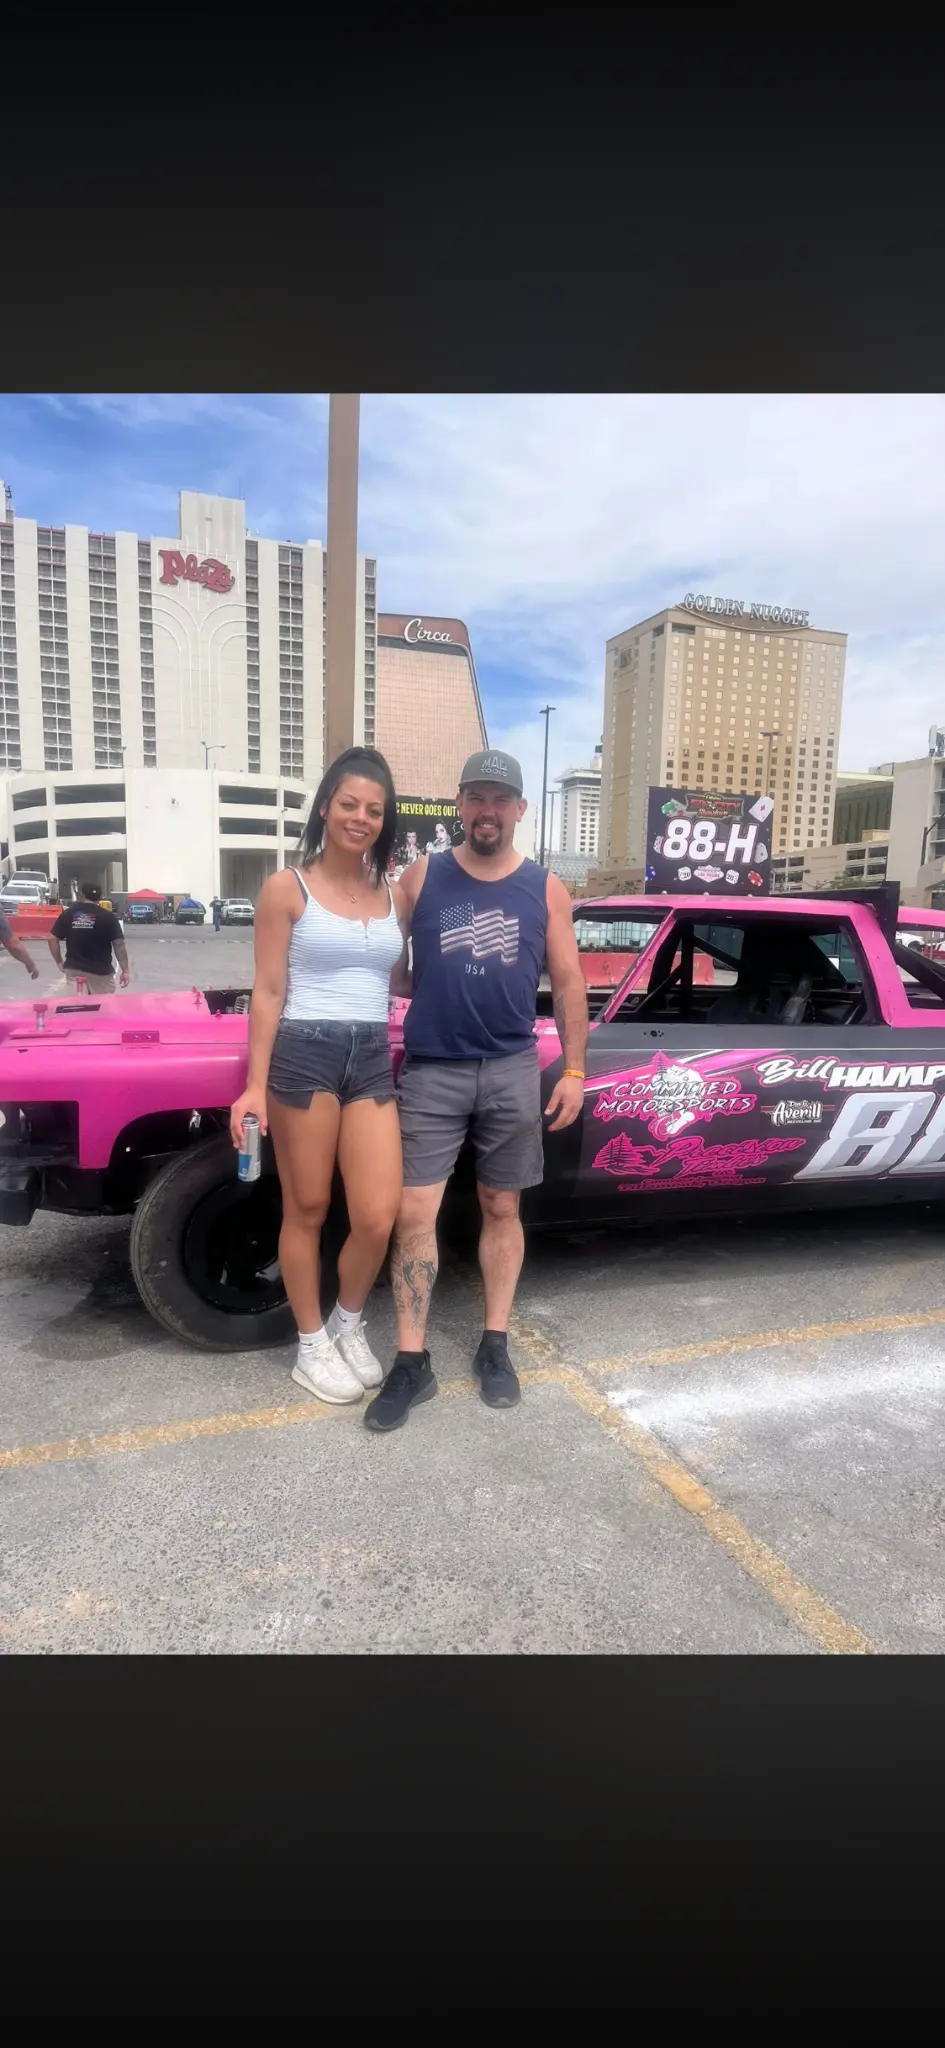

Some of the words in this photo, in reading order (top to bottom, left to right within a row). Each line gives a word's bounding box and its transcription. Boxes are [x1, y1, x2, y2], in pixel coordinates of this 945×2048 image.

[158, 549, 236, 593] Plaza
[684, 593, 745, 617] GOLDEN
[750, 602, 809, 626] NUGGET
[404, 618, 452, 643] Circa
[480, 768, 508, 777] TOOLS
[481, 756, 507, 770] MAC
[401, 802, 423, 815] NEVER
[424, 804, 442, 816] GOES
[443, 805, 456, 817] OUT
[663, 819, 758, 863] 88-H
[465, 963, 485, 975] USA
[757, 1059, 837, 1084] Bill
[613, 1081, 737, 1098] COMMITTED
[599, 1097, 751, 1114] MOTORSPORTS
[772, 1101, 821, 1125] Averill
